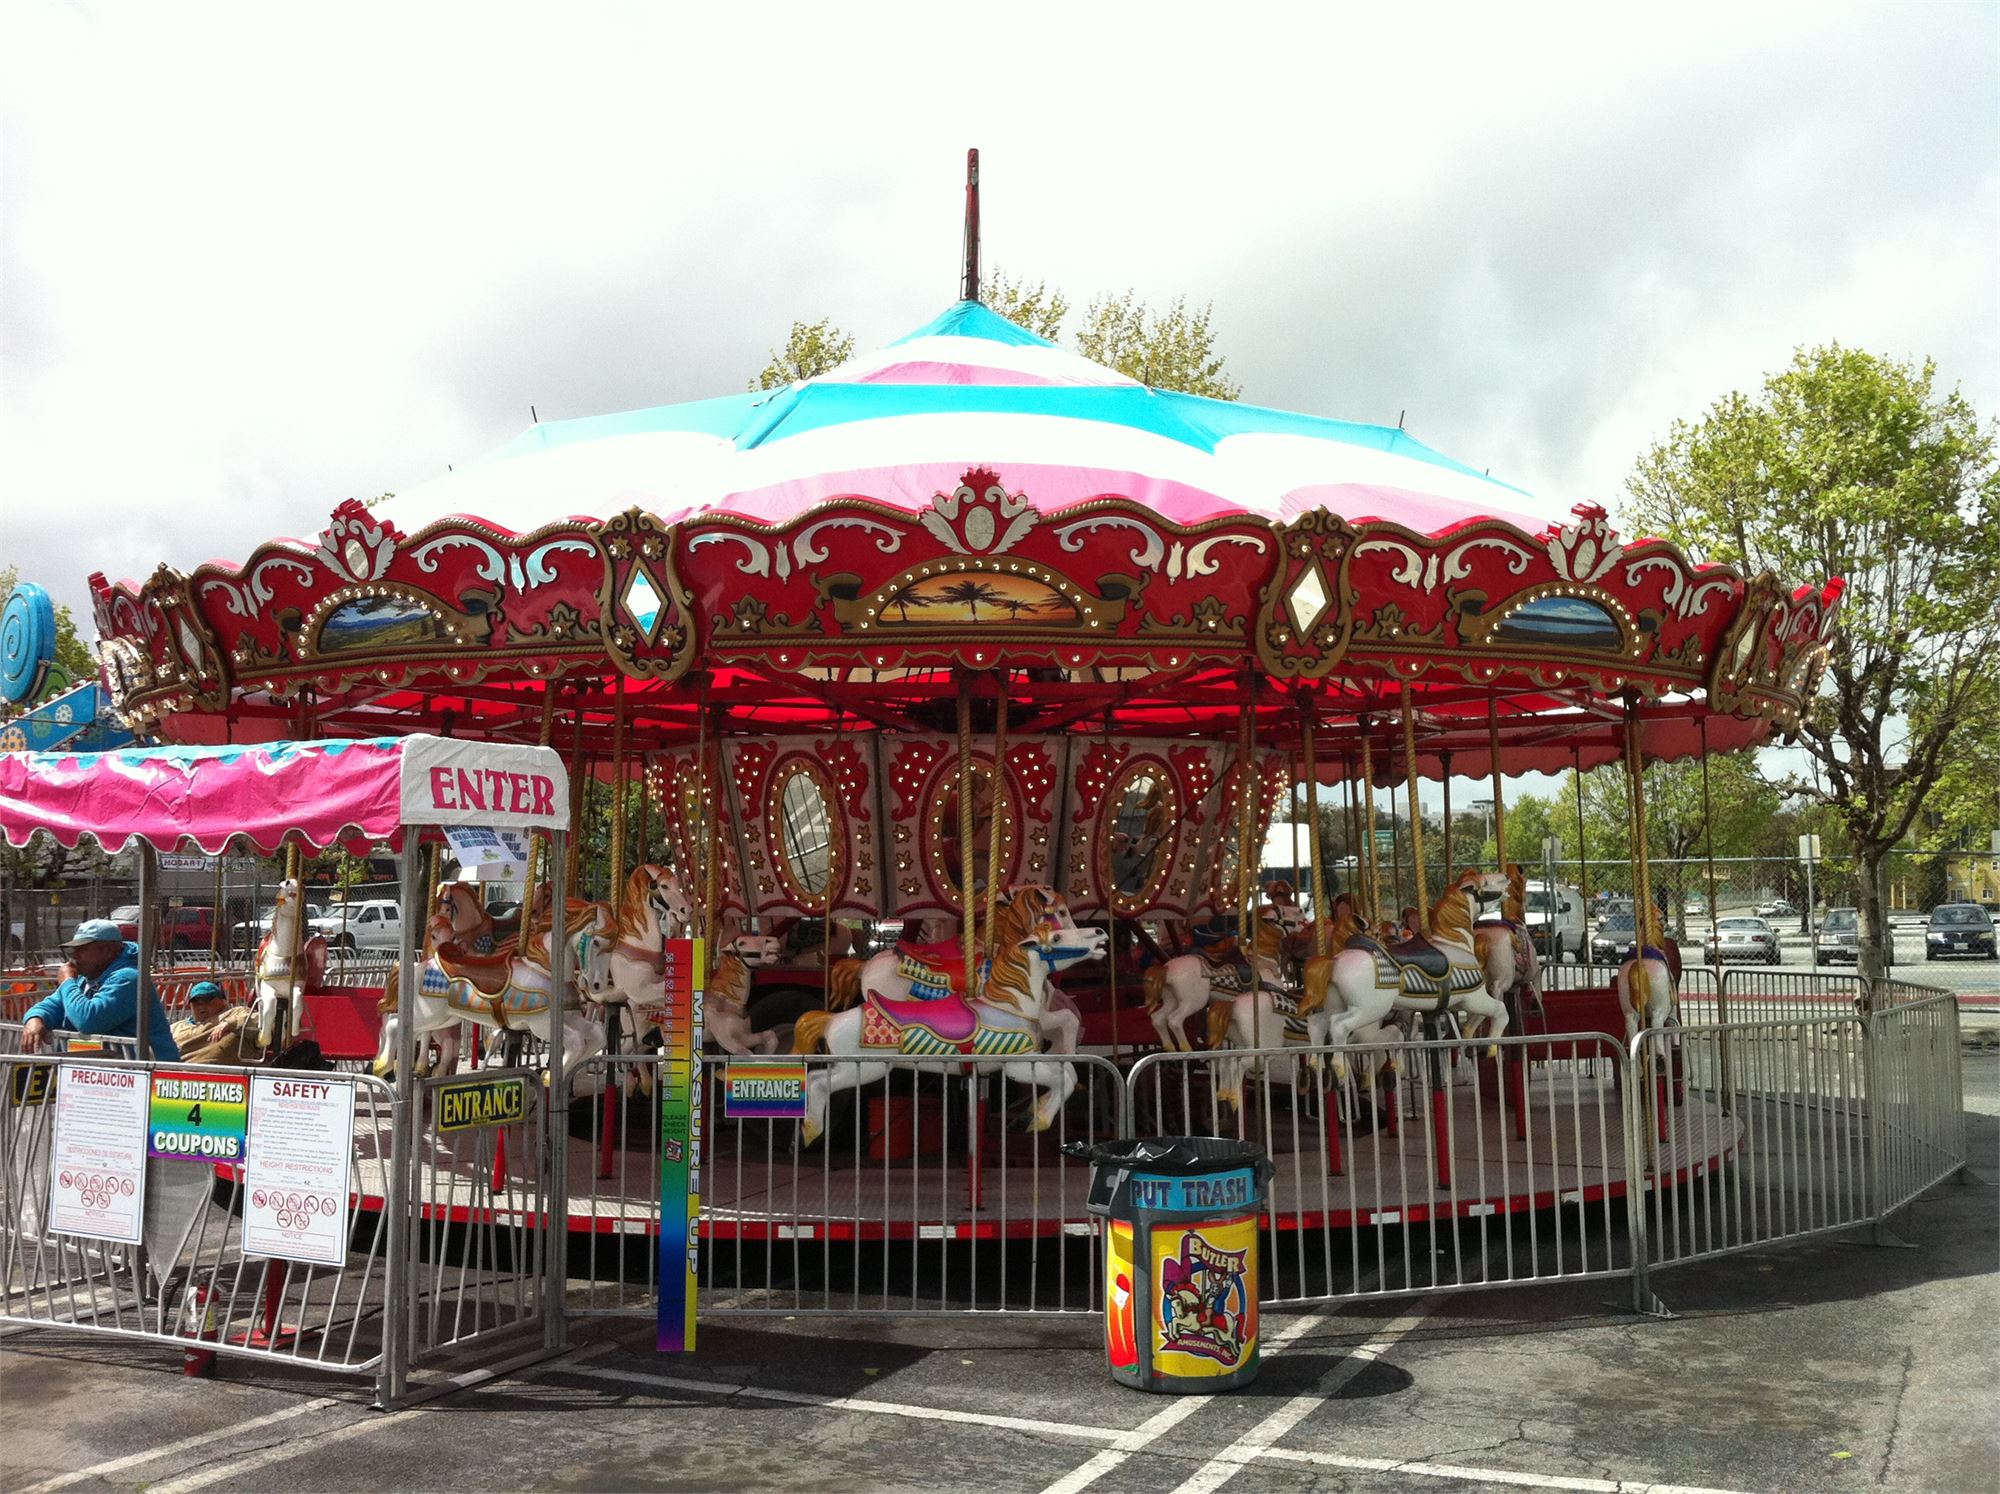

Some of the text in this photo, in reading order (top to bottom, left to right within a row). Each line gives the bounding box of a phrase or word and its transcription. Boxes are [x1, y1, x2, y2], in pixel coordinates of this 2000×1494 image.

[430, 766, 555, 816] ENTER
[164, 858, 201, 867] HOBART
[72, 1070, 135, 1088] PRECAUCION
[155, 1079, 180, 1098] THIS
[181, 1081, 207, 1100] RIDE
[207, 1083, 243, 1103] TAKES
[273, 1082, 330, 1099] SAFETY
[734, 1079, 800, 1099] ENTRANCE
[187, 1104, 202, 1126] 4
[444, 1086, 519, 1122] ENTRANCE
[688, 990, 704, 1274] MEASURE UP
[153, 1132, 239, 1157] COUPONS
[1130, 1177, 1248, 1208] PUT TRASH
[1188, 1238, 1241, 1273] BUTLER
